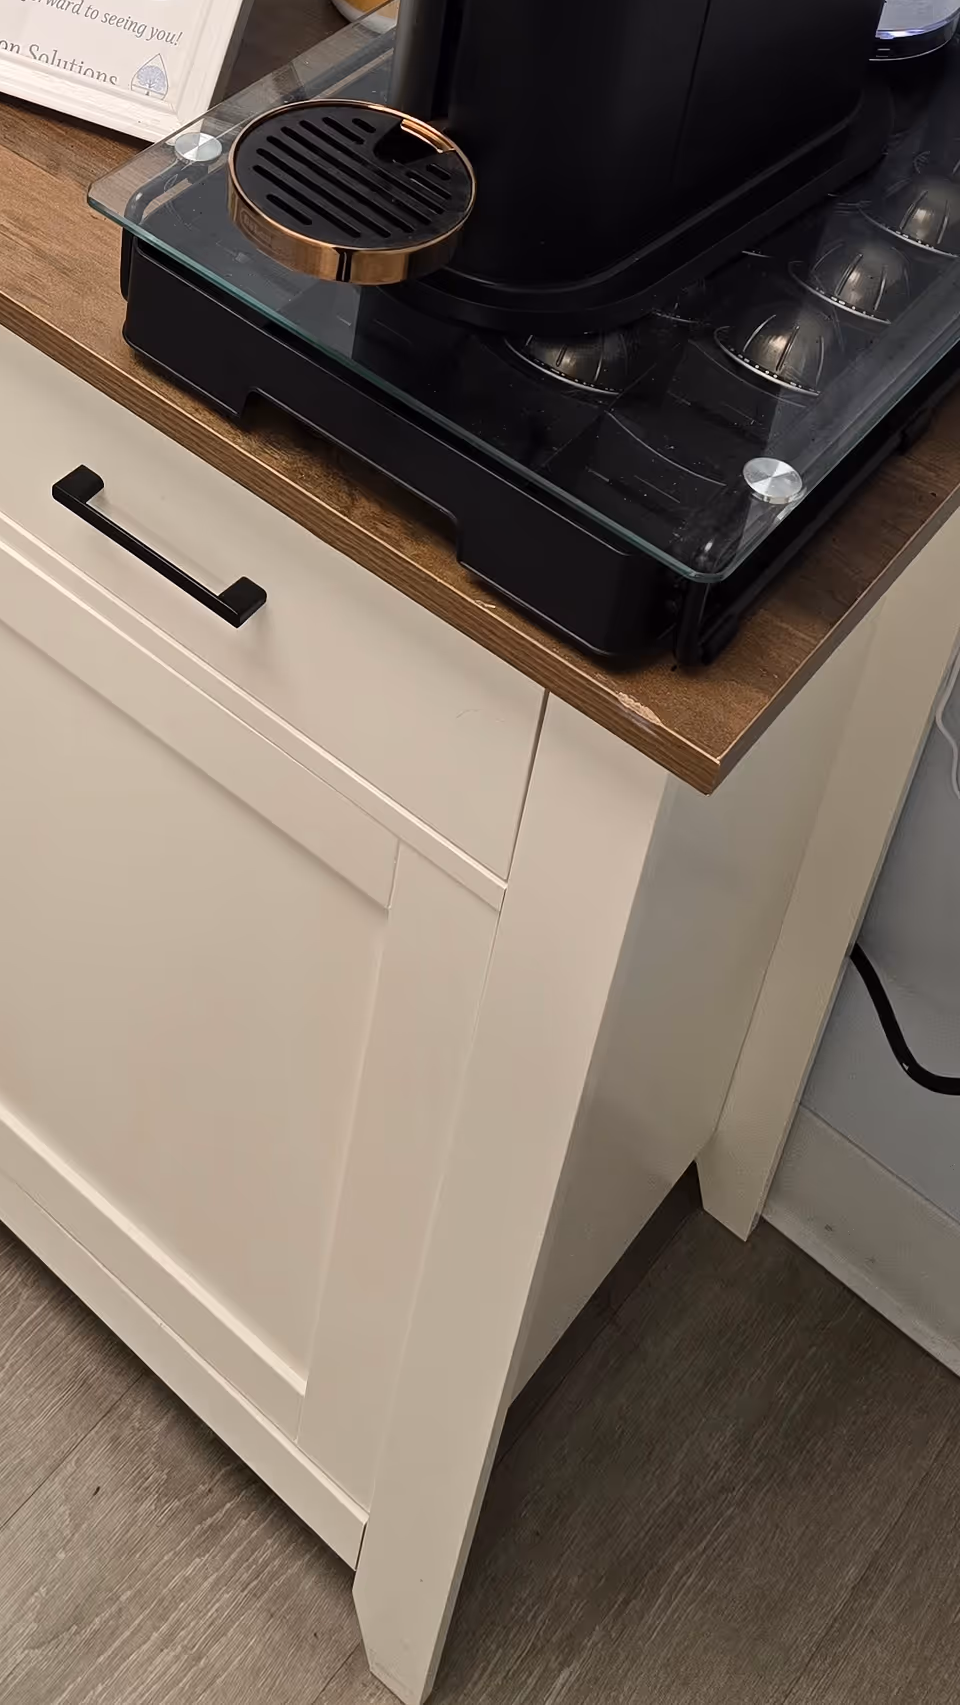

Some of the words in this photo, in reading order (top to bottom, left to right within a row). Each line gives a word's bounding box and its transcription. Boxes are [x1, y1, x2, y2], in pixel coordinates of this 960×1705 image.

[84, 4, 100, 20] to
[100, 12, 148, 39] seeing
[145, 26, 183, 46] you!
